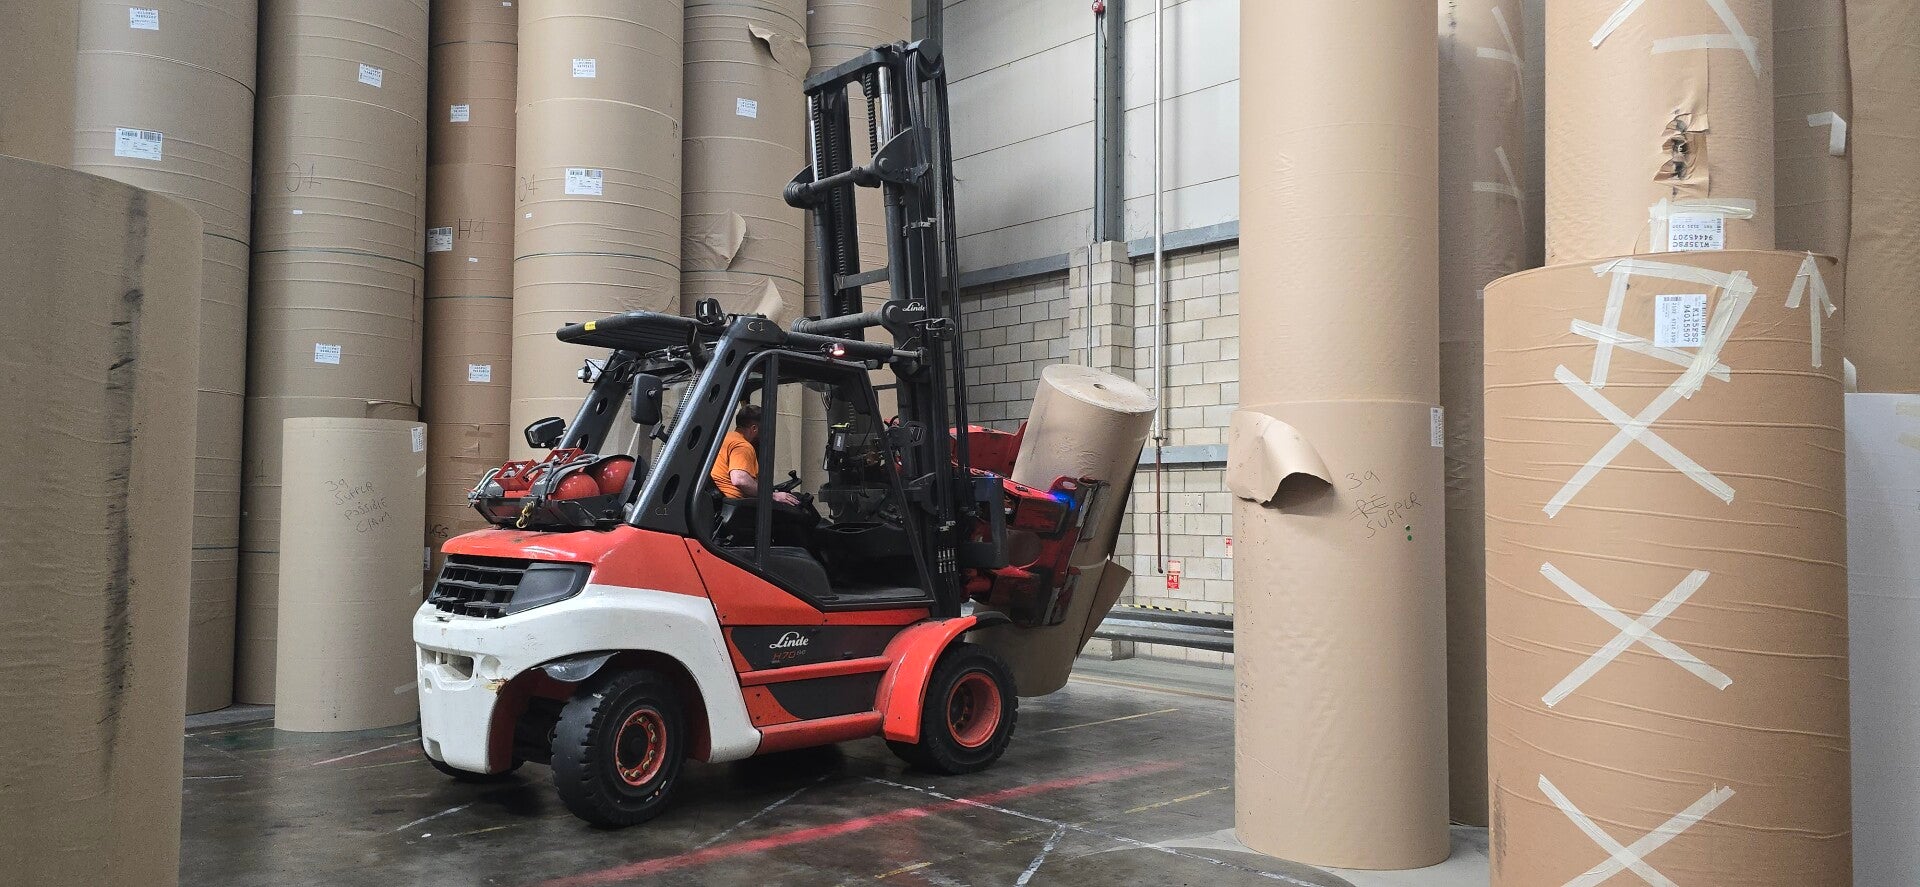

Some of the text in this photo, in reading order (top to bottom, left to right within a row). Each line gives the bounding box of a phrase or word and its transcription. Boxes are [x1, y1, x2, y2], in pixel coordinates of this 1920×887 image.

[458, 218, 489, 241] H4
[747, 321, 765, 332] C1
[1682, 303, 1692, 343] 94015507
[1691, 306, 1701, 343] K135FSC
[769, 631, 809, 649] Linde
